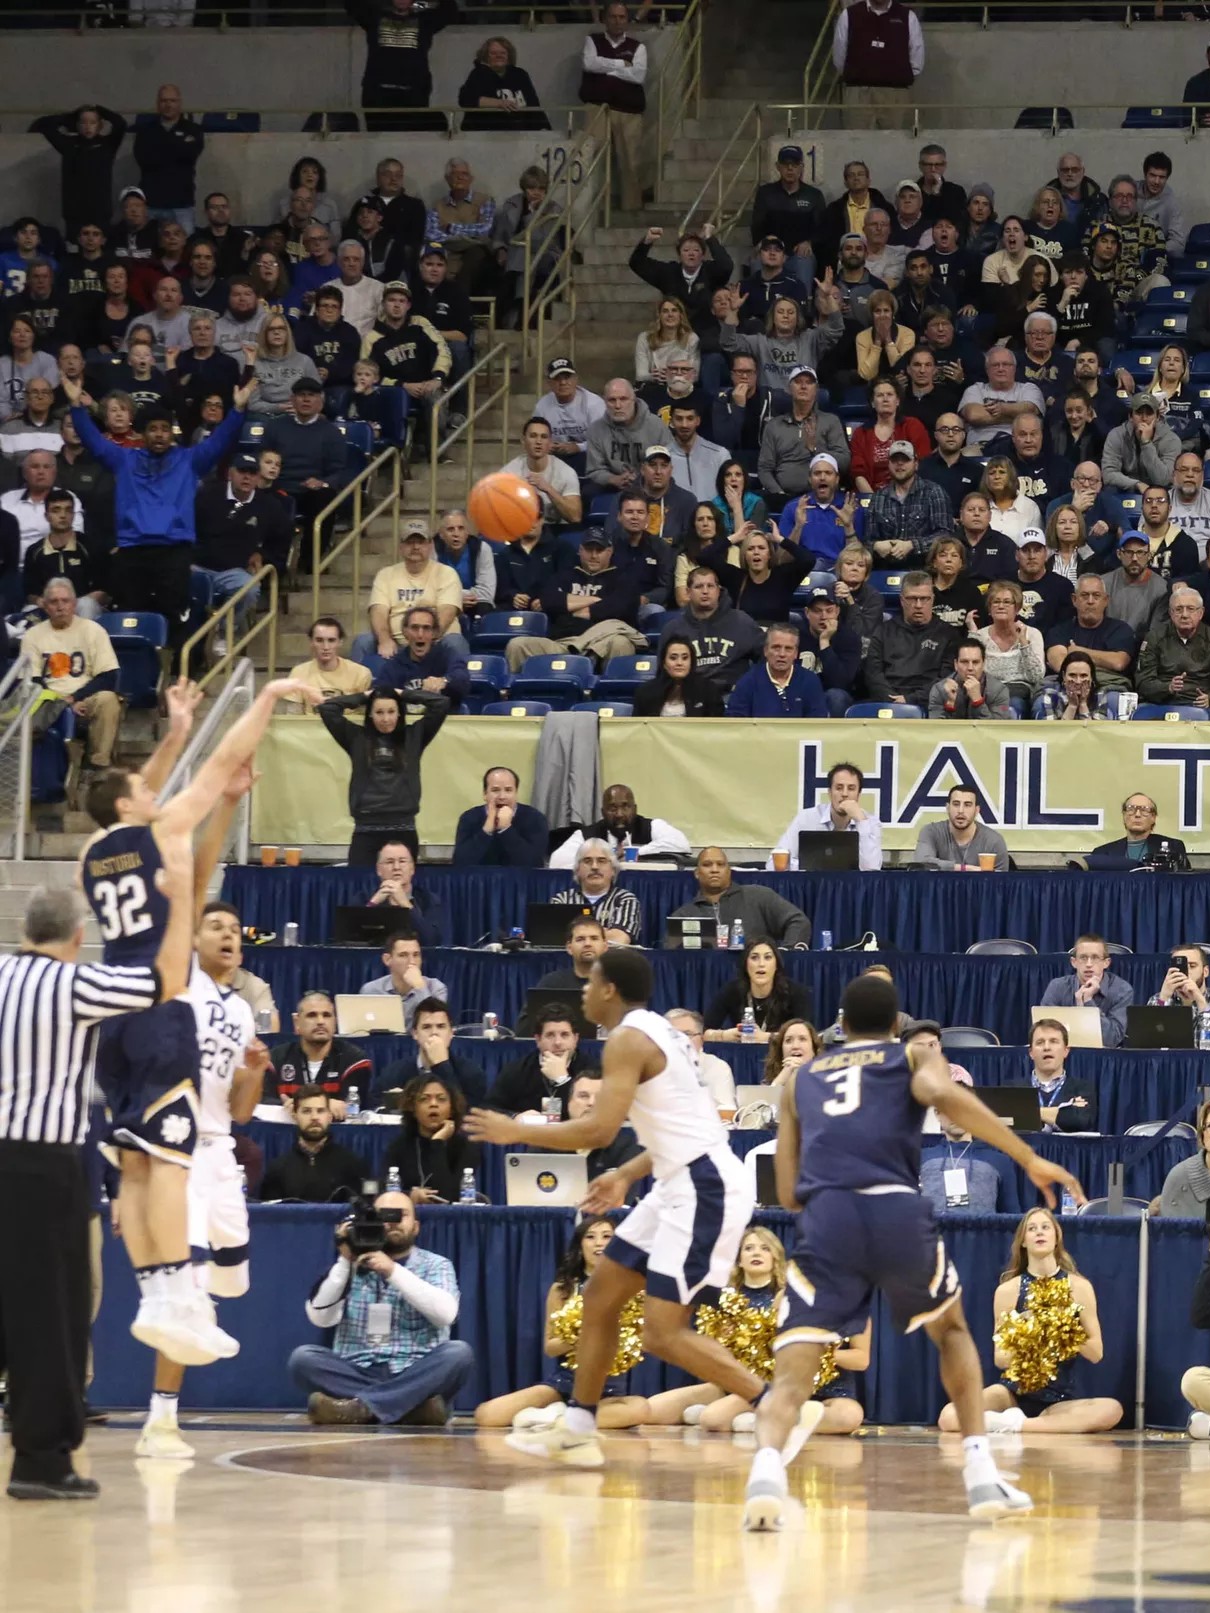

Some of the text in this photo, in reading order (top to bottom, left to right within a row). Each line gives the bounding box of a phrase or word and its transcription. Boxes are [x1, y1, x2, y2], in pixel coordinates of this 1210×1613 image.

[1032, 235, 1064, 259] Pitt
[1065, 302, 1090, 321] ITT
[384, 341, 417, 367] PITT
[772, 346, 798, 364] Pitt
[1024, 530, 1040, 538] PITT
[572, 582, 604, 597] PITT
[692, 637, 735, 658] ITT
[800, 740, 1104, 831] HAIL
[92, 874, 154, 941] 32
[200, 1037, 234, 1079] 23
[823, 1065, 862, 1116] 3
